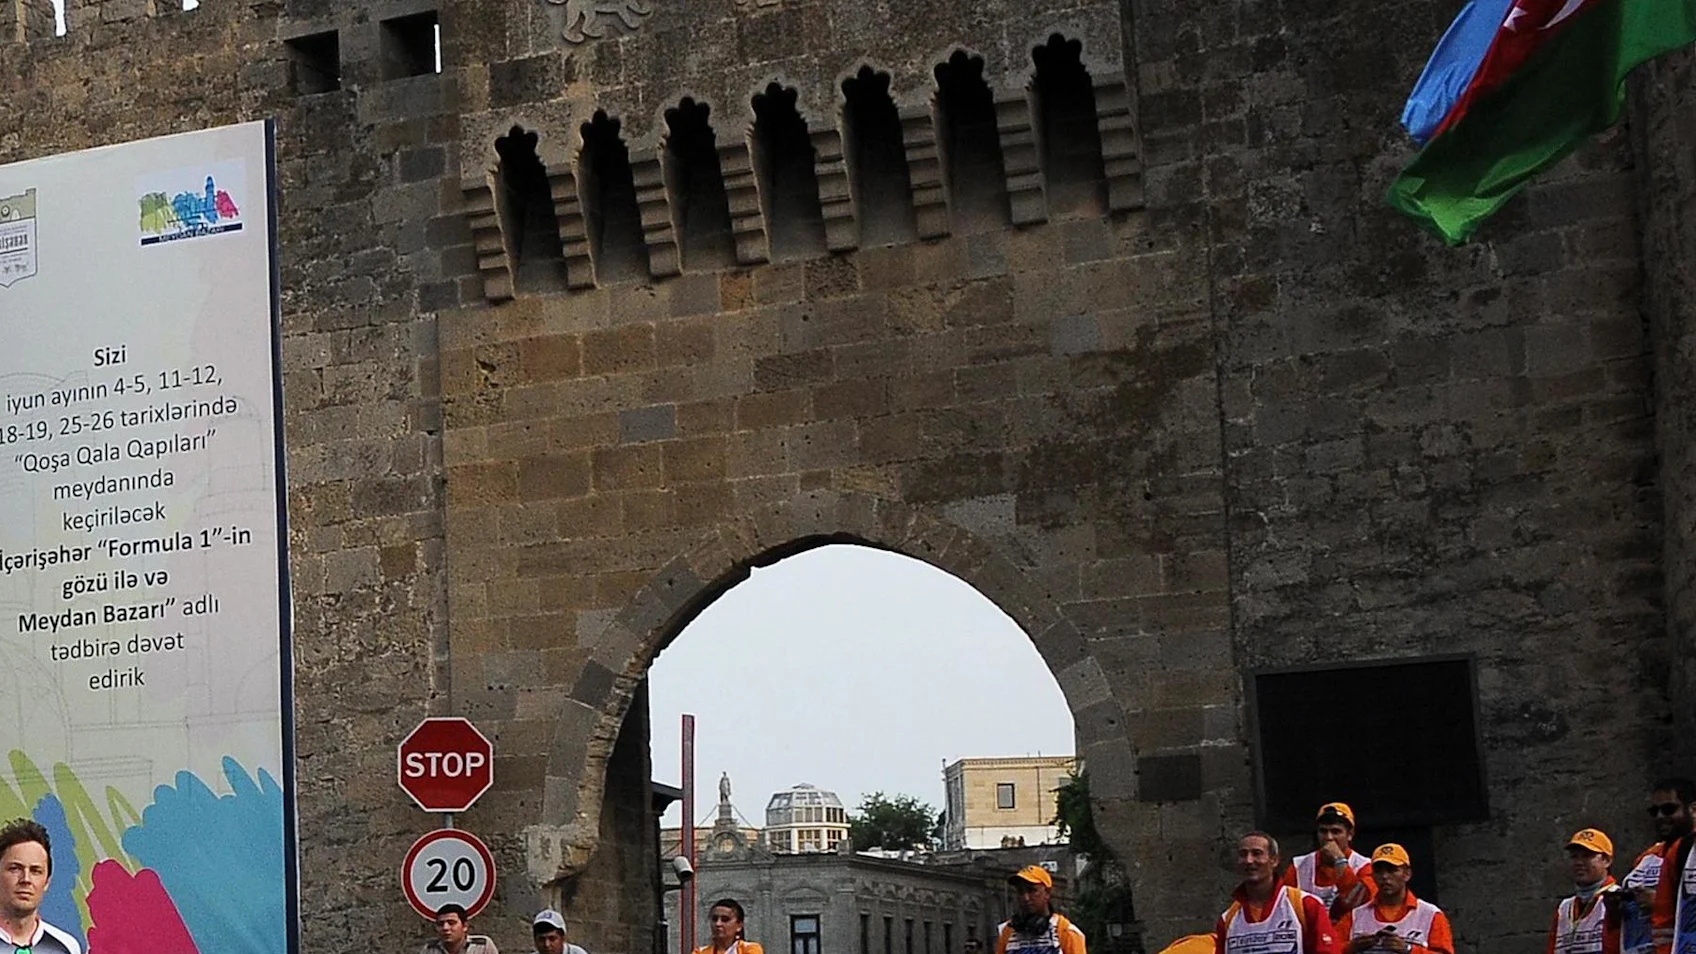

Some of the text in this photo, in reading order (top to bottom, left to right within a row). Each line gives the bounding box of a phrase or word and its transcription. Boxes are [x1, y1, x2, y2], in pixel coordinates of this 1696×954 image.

[94, 344, 126, 367] Sizi
[7, 365, 222, 415] iyun ayının 4-5, 11-12,
[60, 411, 114, 435] 25-26
[121, 396, 237, 427] tarixlərində
[15, 429, 216, 473] “Qoşa Qala Qapıları”
[54, 468, 174, 500] meydanında
[63, 501, 166, 532] keçiriləcək
[97, 531, 193, 557] “Formula
[200, 526, 251, 548] 1”-in
[63, 570, 168, 600] gözü ilə və
[19, 594, 219, 633] Meydan Bazarı” adlı
[51, 632, 185, 661] tədbirə dəvət
[89, 667, 145, 690] edirik
[405, 752, 485, 778] STOP
[426, 857, 476, 893] 20
